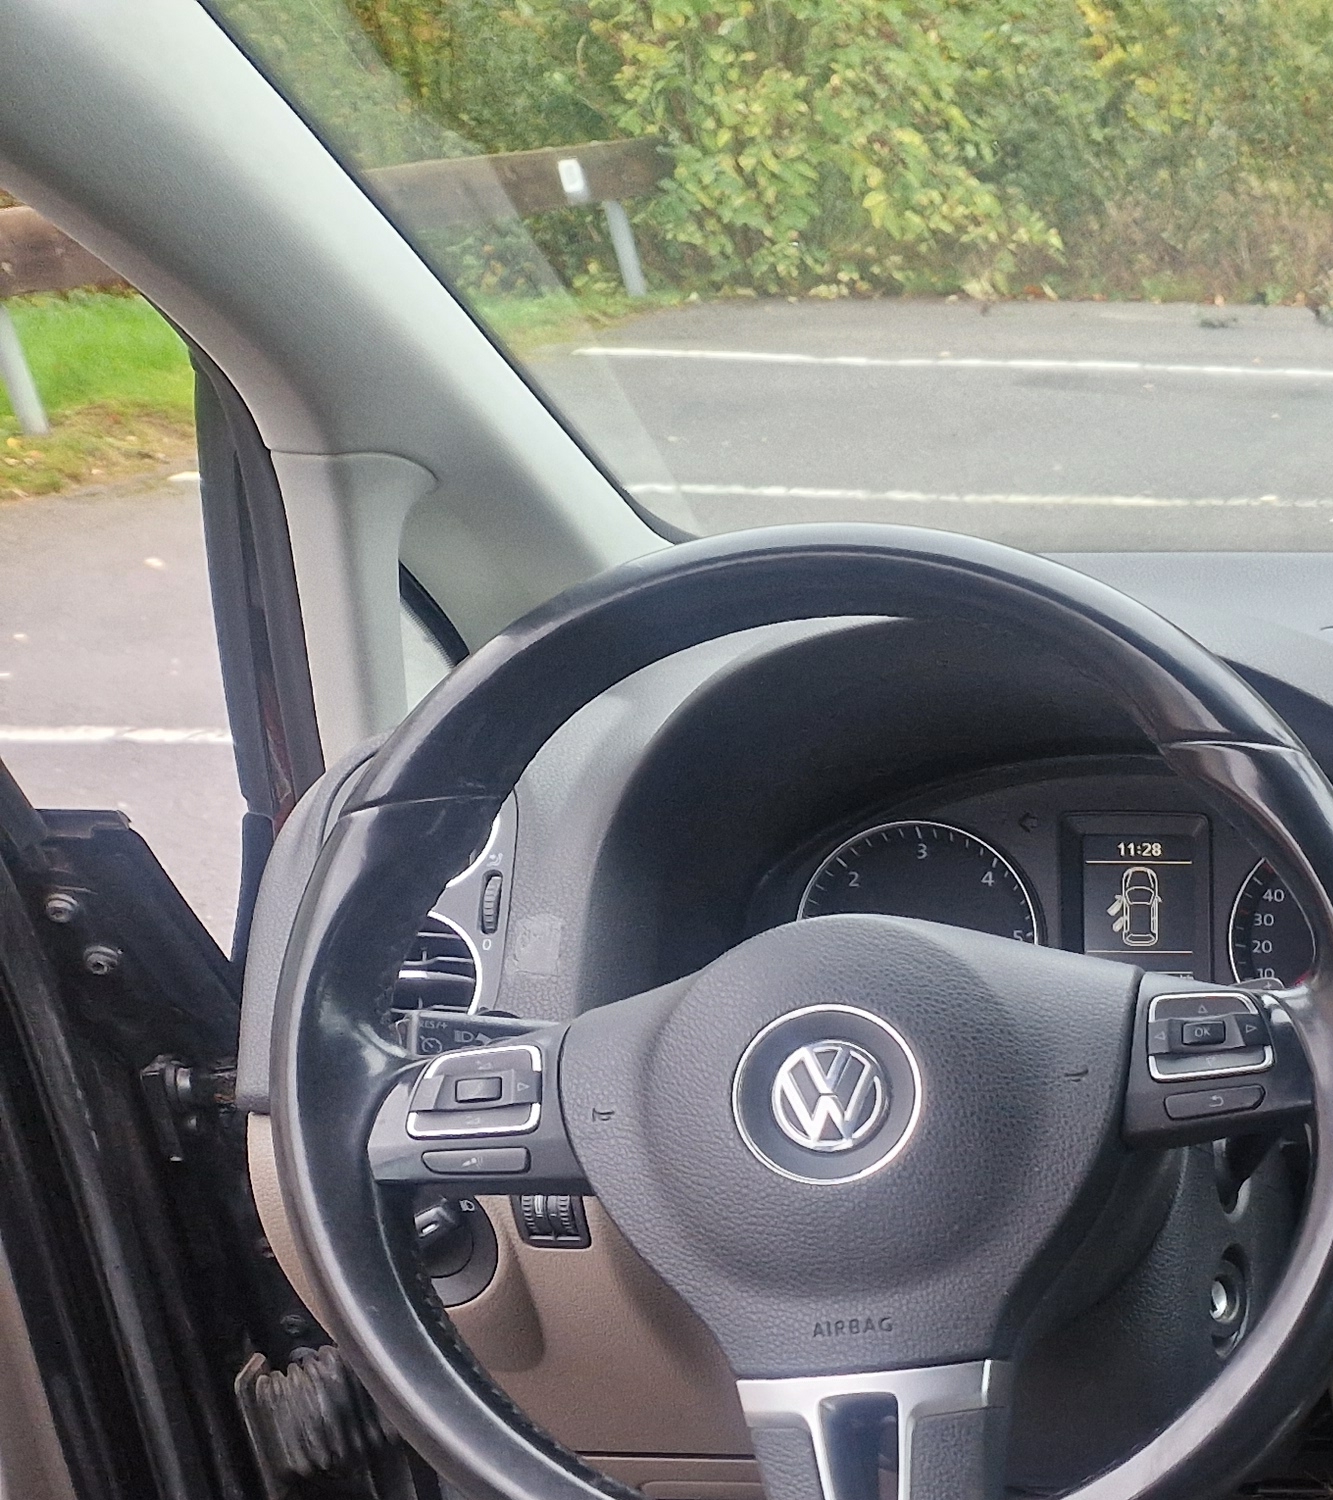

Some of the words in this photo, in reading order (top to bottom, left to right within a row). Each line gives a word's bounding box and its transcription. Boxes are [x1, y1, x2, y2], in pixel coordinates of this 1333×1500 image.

[916, 844, 928, 859] 3
[1117, 842, 1162, 856] 11:28
[848, 871, 860, 887] 2
[981, 871, 994, 886] 4
[1262, 889, 1285, 902] 40
[1253, 913, 1275, 926] 30
[1252, 940, 1273, 953] 20
[1194, 1026, 1211, 1037] OK
[813, 1316, 893, 1338] AIRBAG
